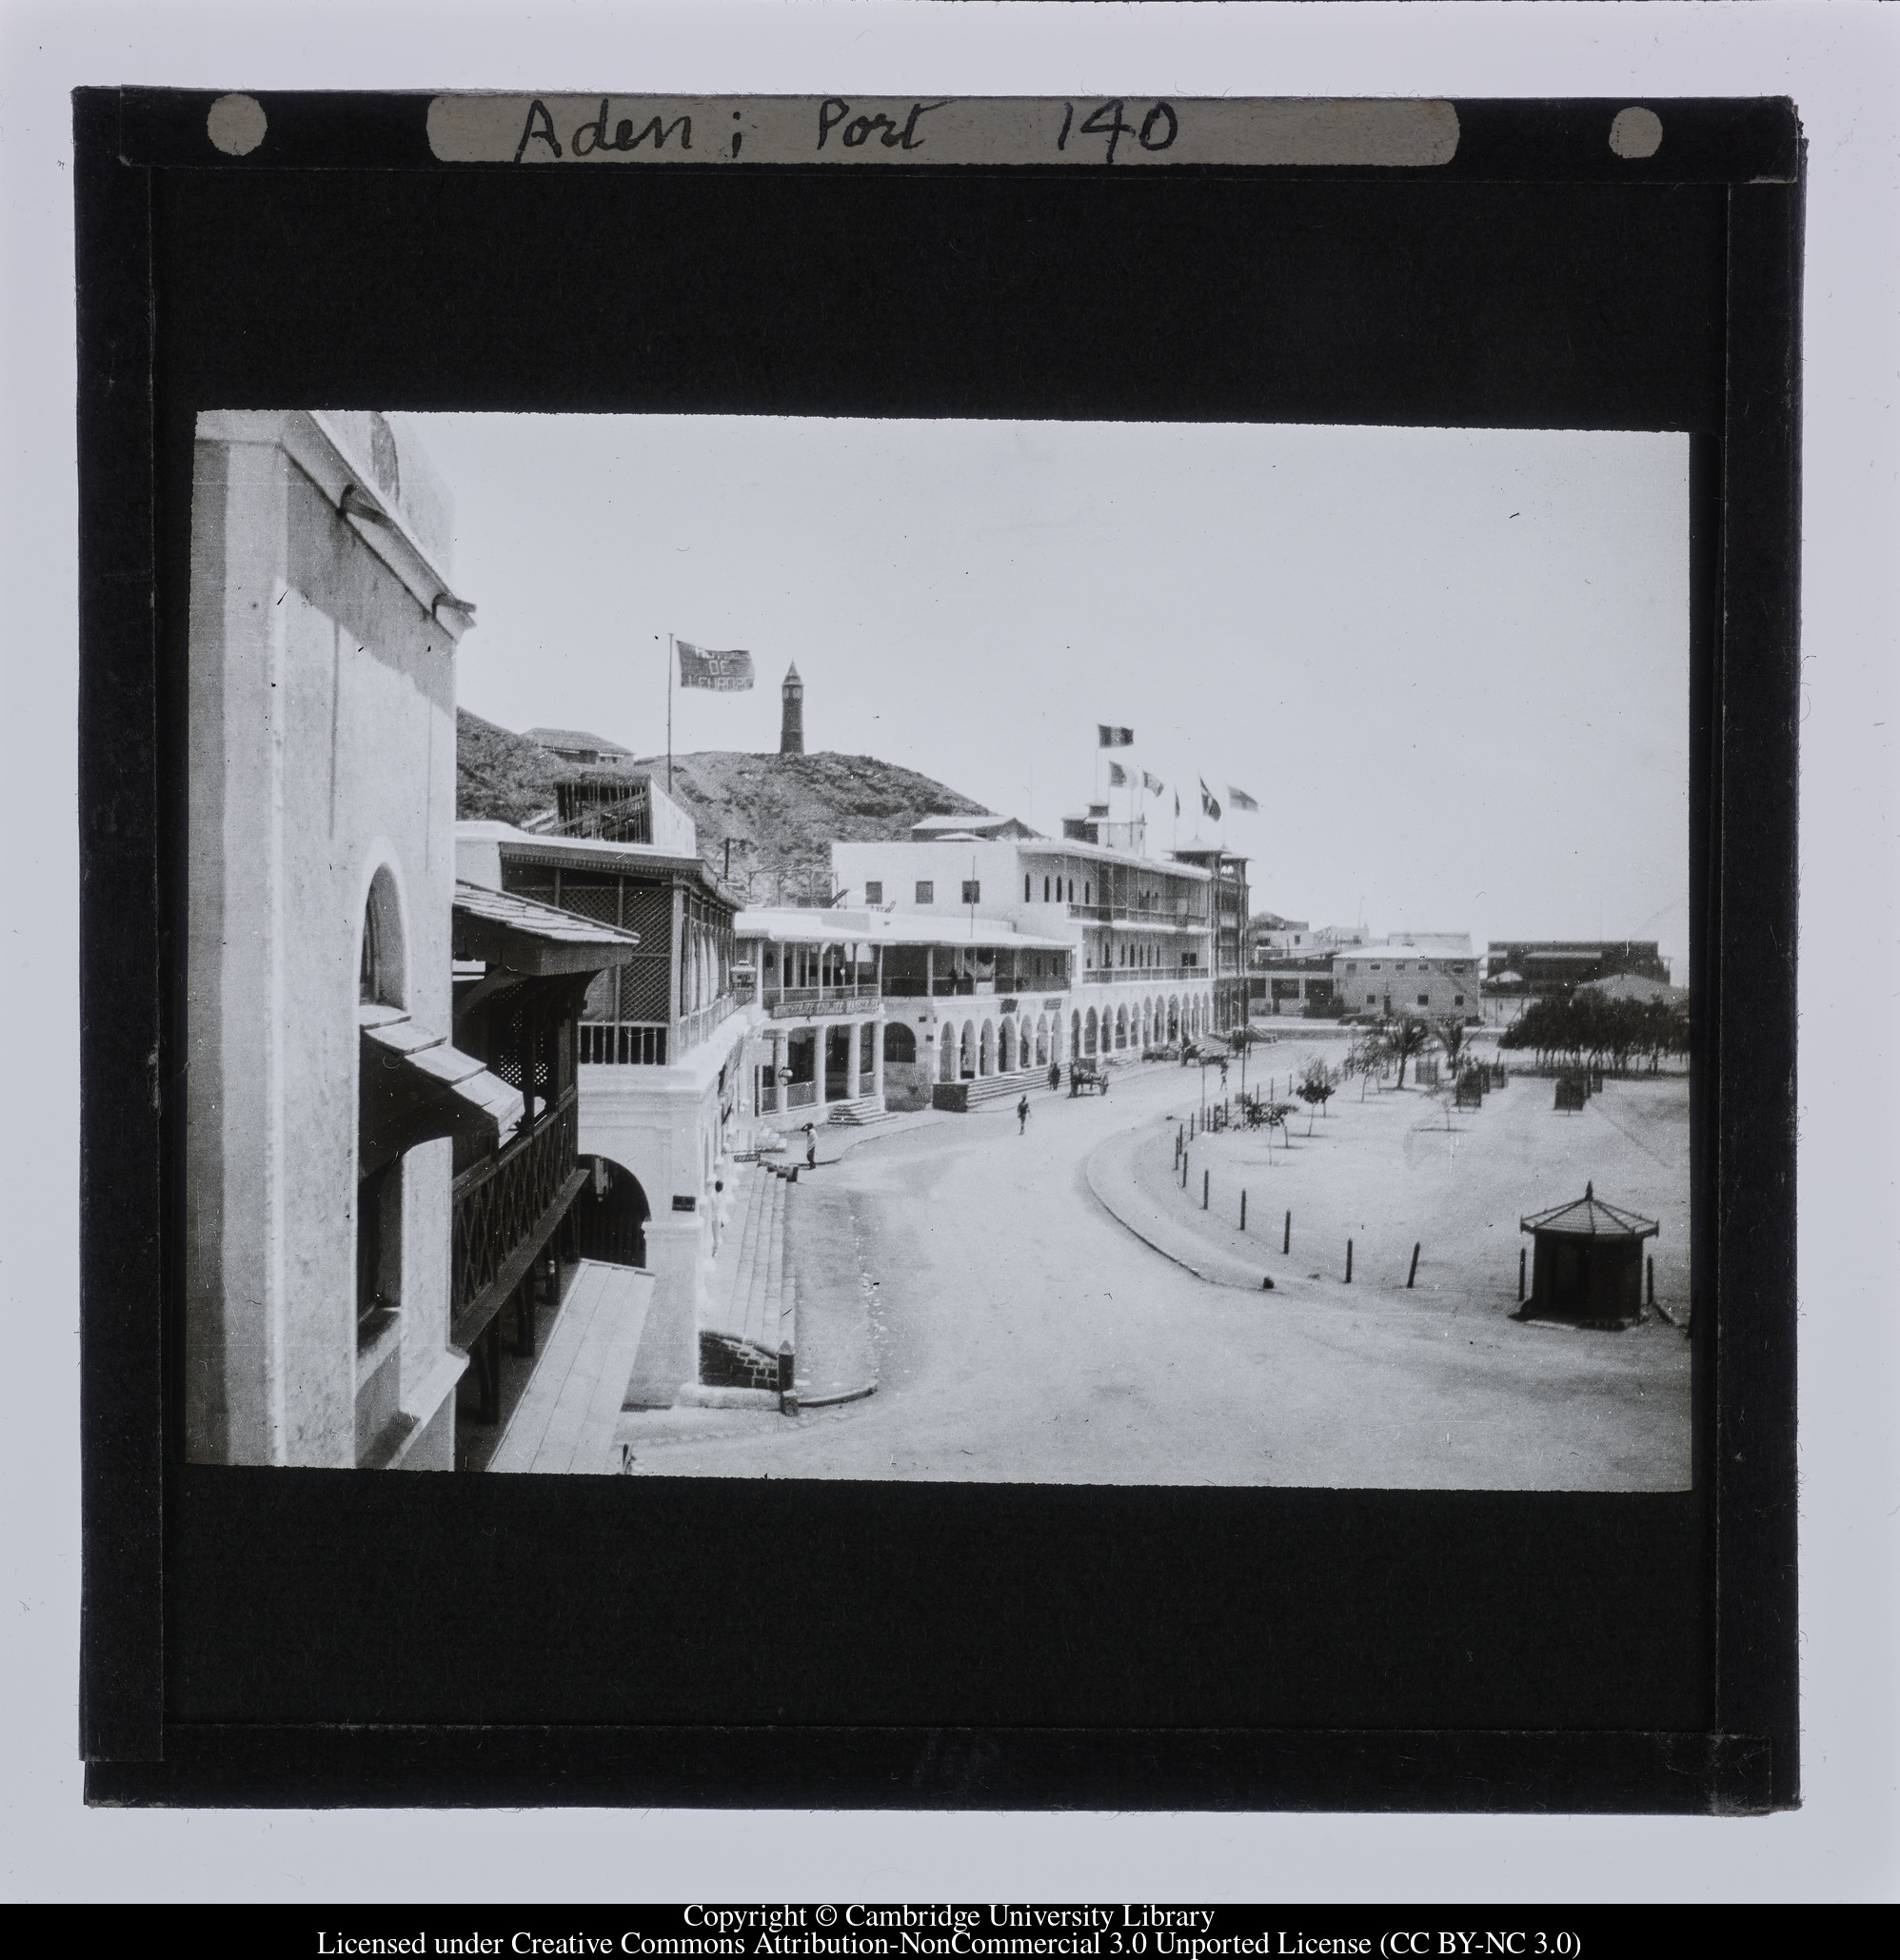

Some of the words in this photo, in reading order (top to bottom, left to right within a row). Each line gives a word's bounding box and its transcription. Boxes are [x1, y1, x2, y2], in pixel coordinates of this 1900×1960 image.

[514, 99, 692, 163] Aden
[818, 98, 949, 149] Port
[1057, 99, 1178, 165] 140
[708, 660, 731, 675] DE
